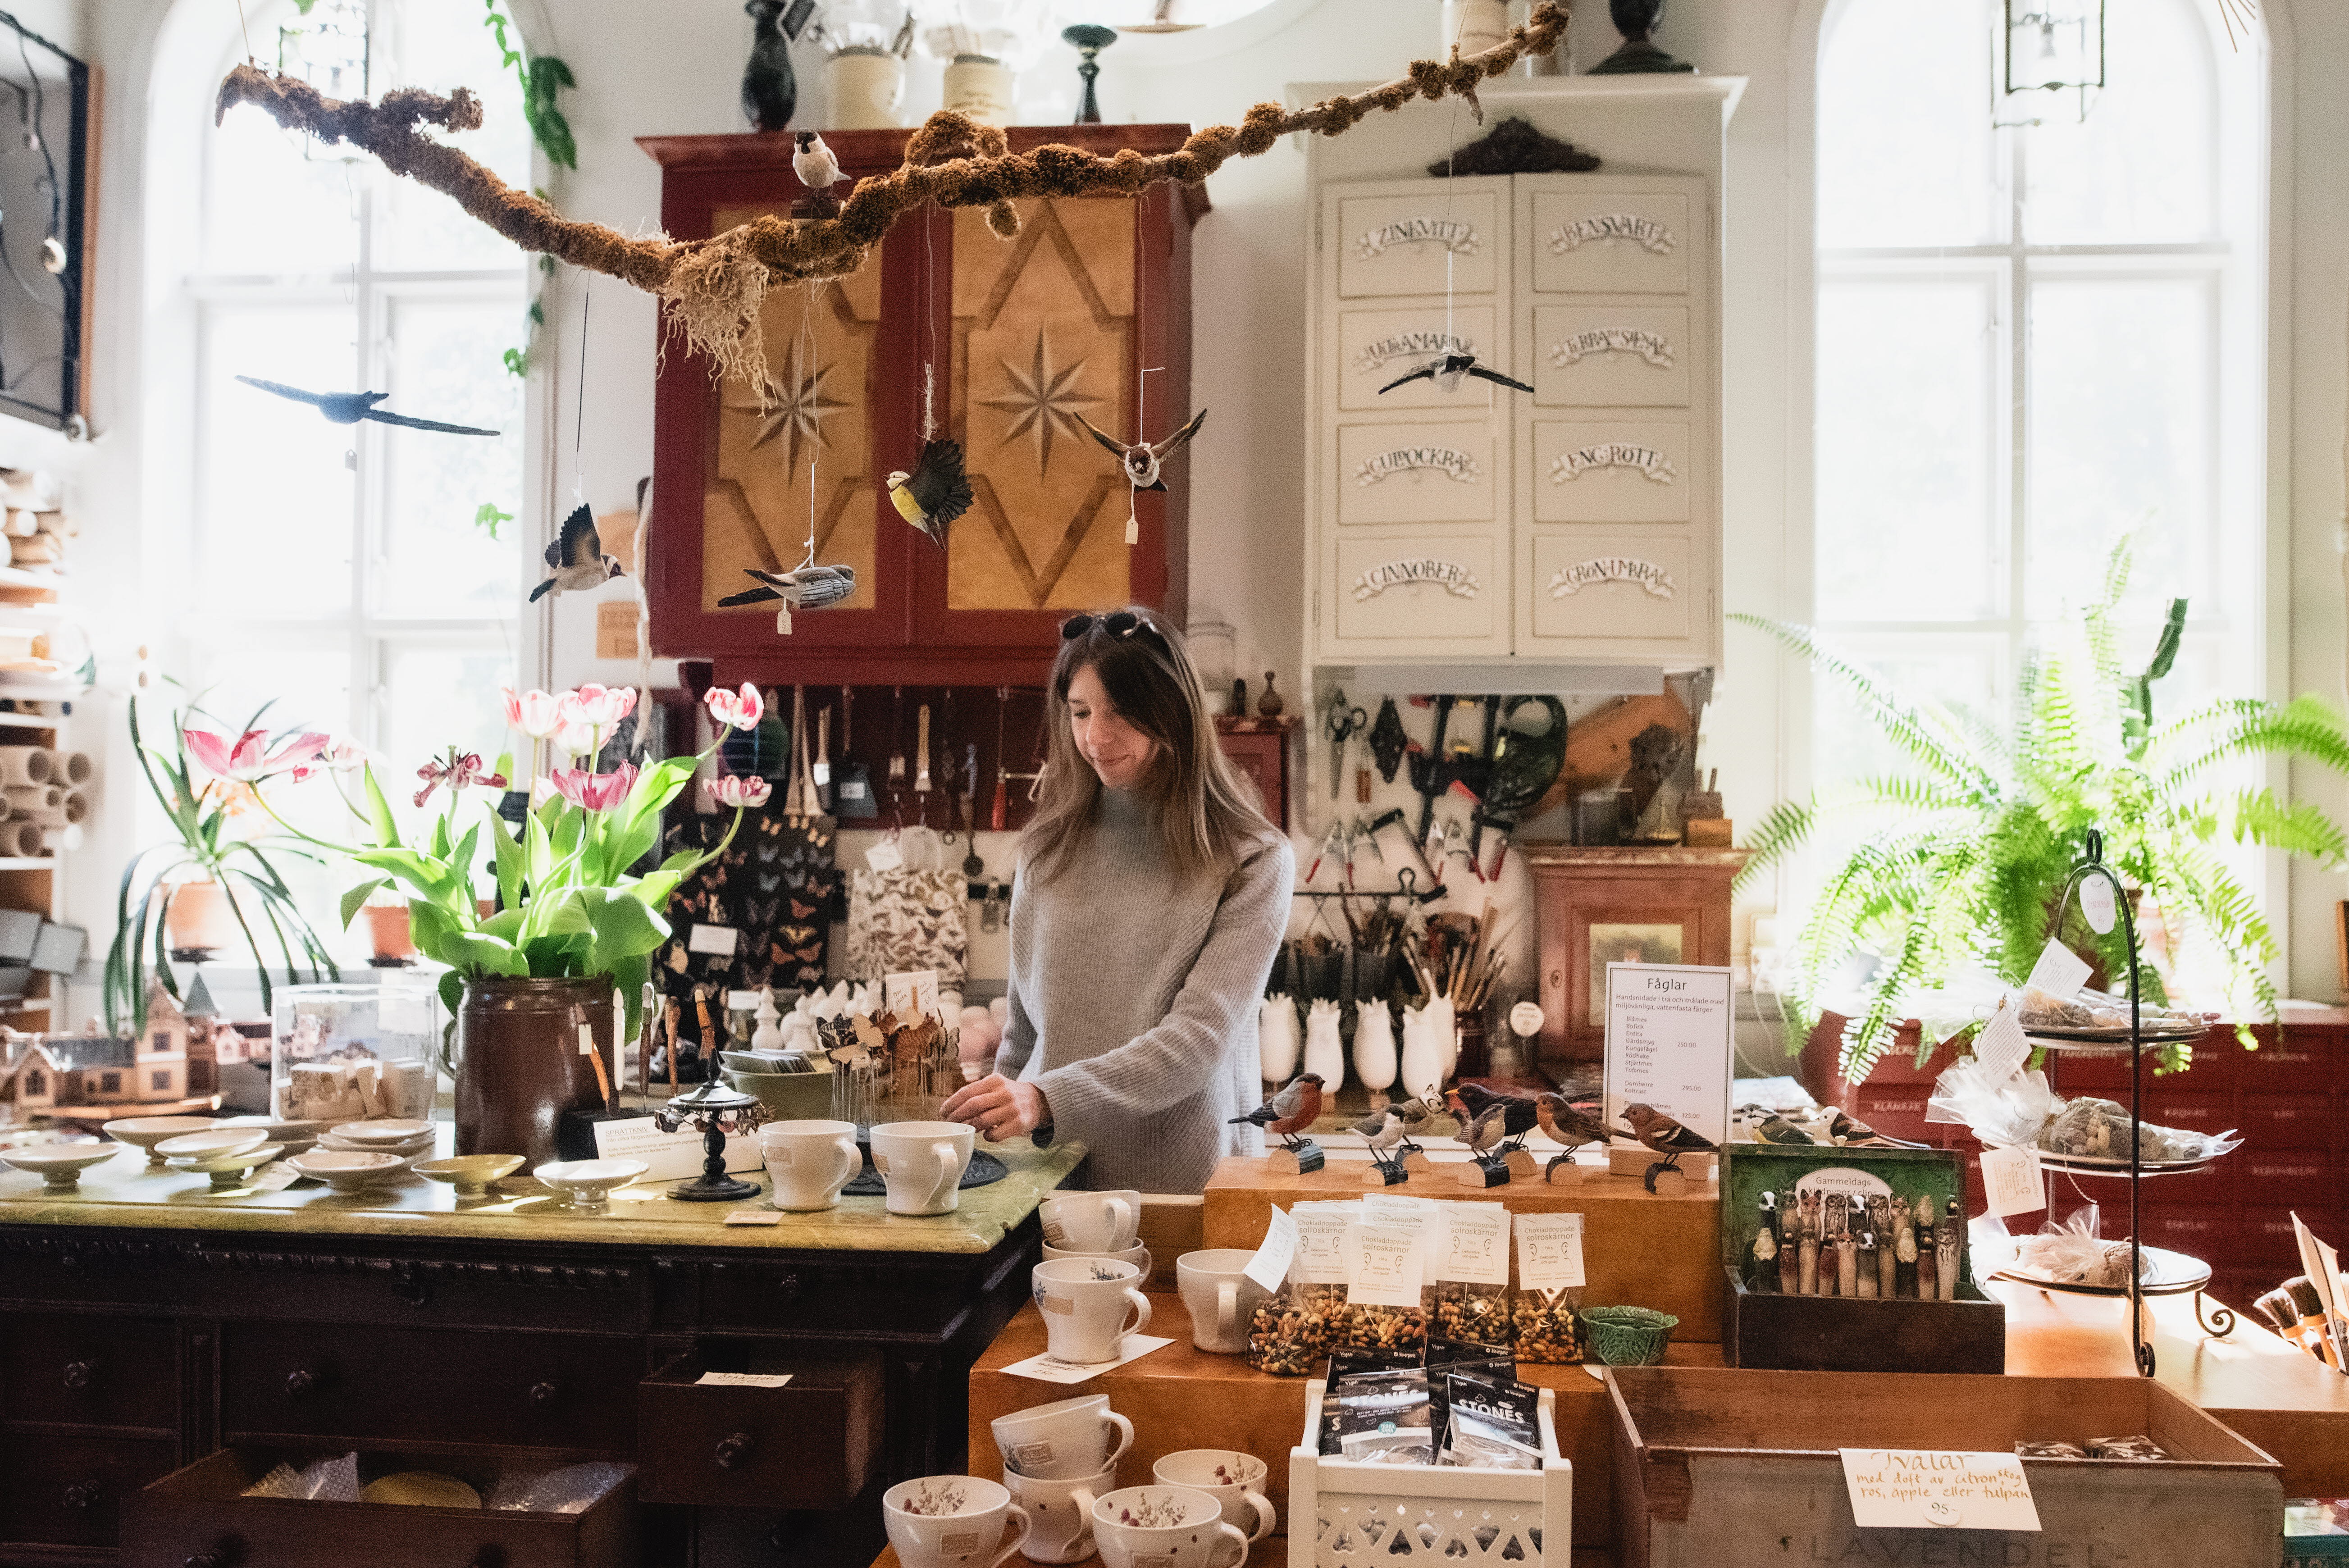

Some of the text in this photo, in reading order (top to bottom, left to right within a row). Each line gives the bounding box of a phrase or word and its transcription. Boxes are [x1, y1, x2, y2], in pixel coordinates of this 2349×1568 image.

[1648, 978, 1687, 993] Fåglar
[1685, 996, 1708, 1004] målade
[1816, 1176, 1871, 1187] Gammeldags
[1372, 1201, 1420, 1209] Chokladdoppade
[1450, 1220, 1500, 1229] Chokladdoppade
[1524, 1226, 1574, 1234] Chokladdoppade
[1451, 1227, 1498, 1236] solroskärnor
[1361, 1235, 1412, 1246] Chokladdoppade
[1362, 1244, 1410, 1253] solroskärnor
[1350, 1389, 1419, 1407] STONES
[1459, 1399, 1525, 1423] STONES
[1856, 1472, 1884, 1484] med
[1894, 1472, 1922, 1486] doft
[1930, 1476, 1943, 1484] av
[1861, 1486, 2030, 1502] ros, äpple eller tulpan
[1811, 1536, 2096, 1567] LAVENDEL
